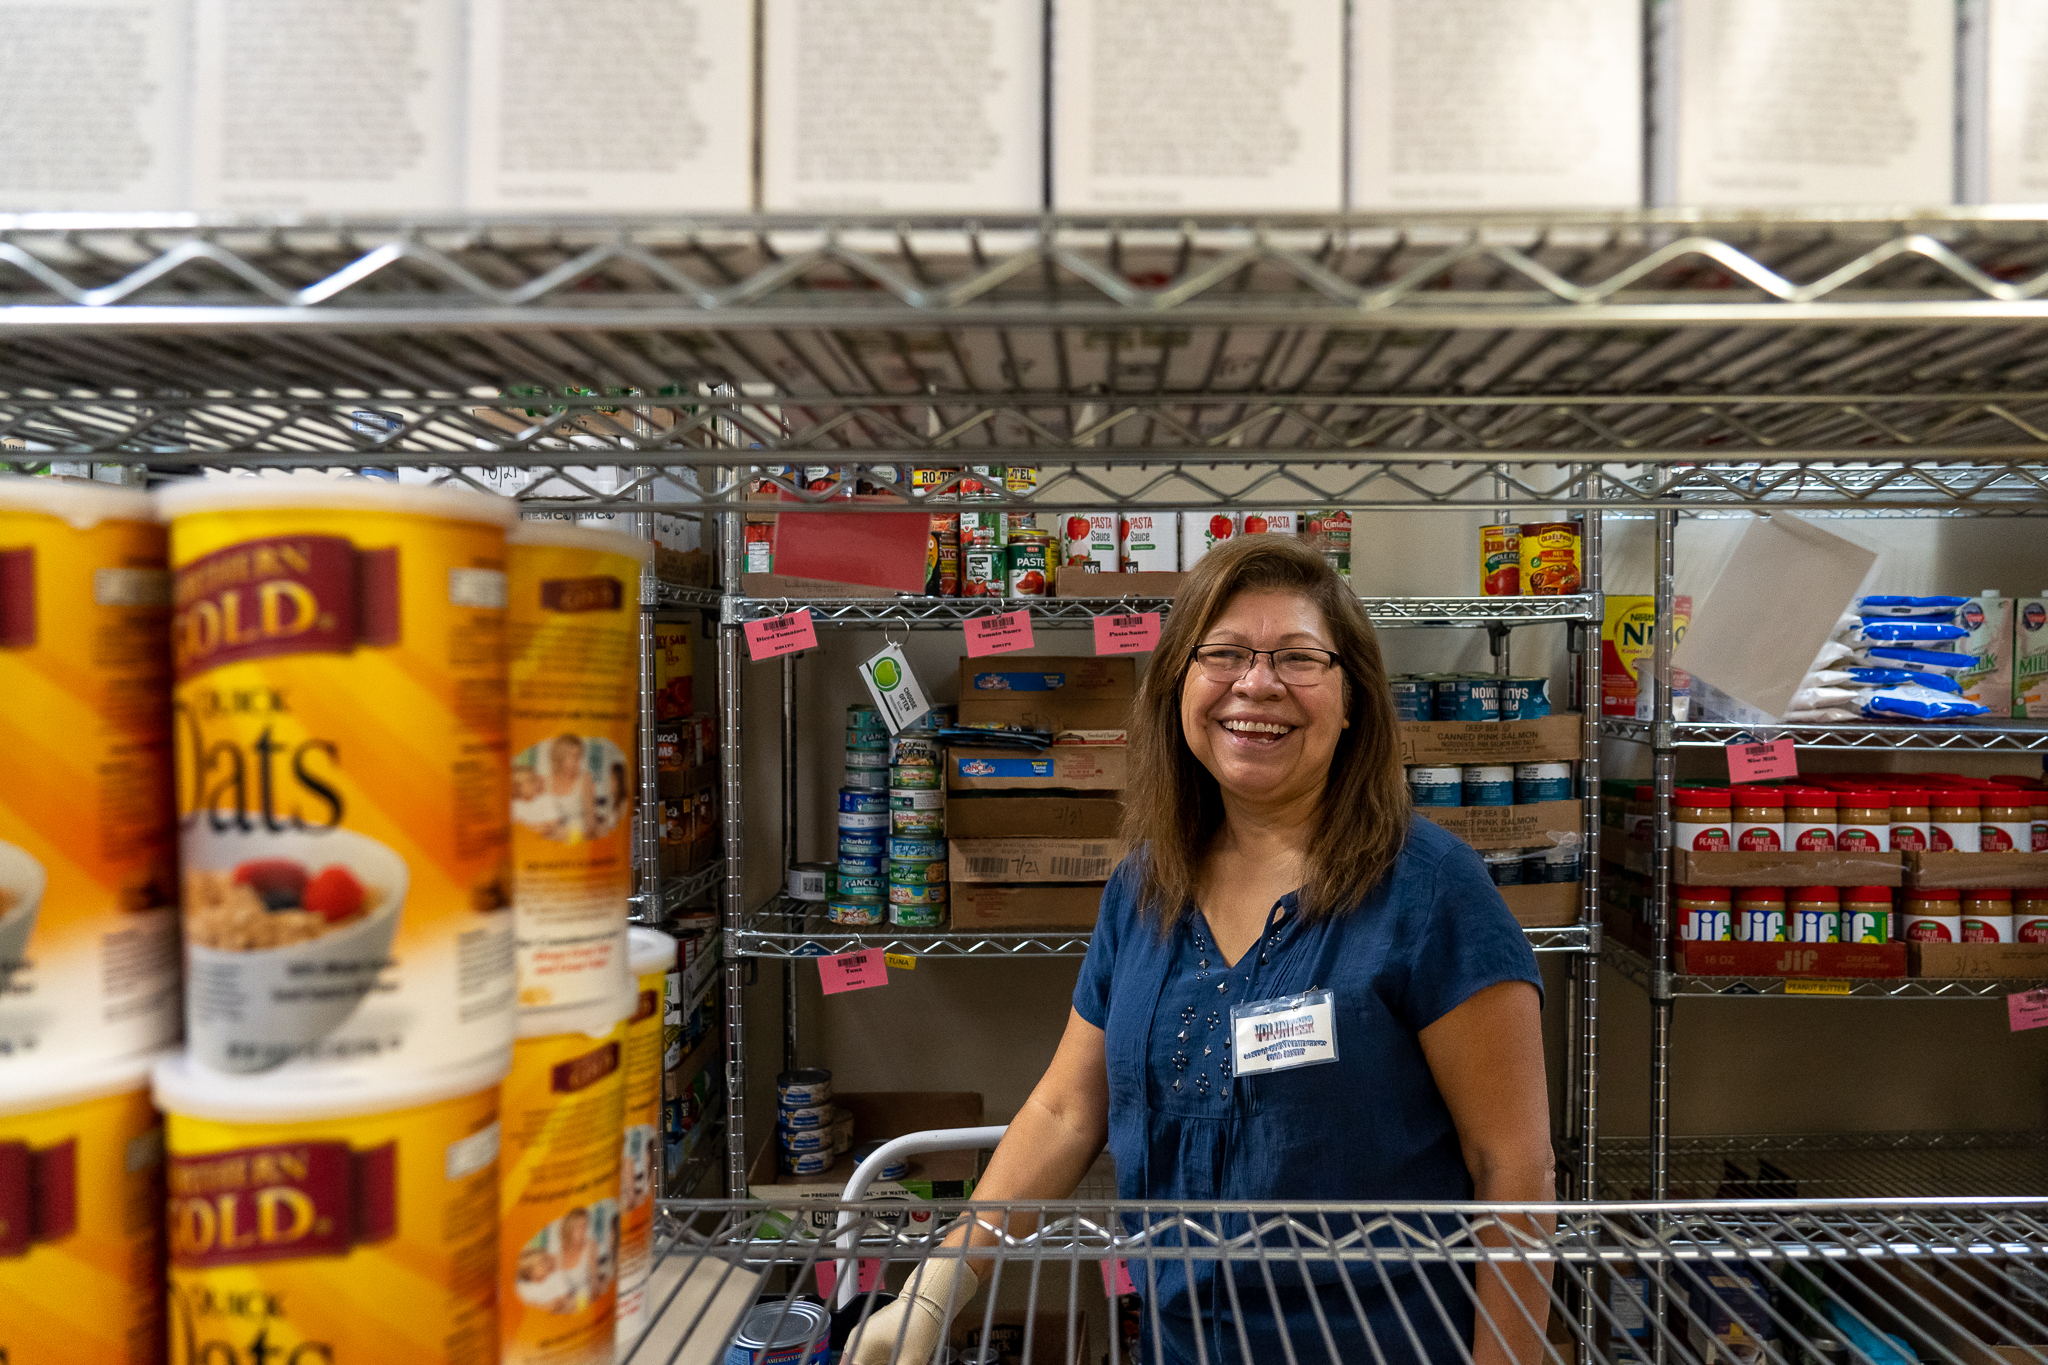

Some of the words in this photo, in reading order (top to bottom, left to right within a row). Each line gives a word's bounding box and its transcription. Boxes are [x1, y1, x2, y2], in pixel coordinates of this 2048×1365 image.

[1090, 516, 1112, 530] PASTA
[1129, 516, 1153, 530] PASTA
[1268, 515, 1290, 529] PASTA
[1090, 530, 1111, 542] Sauce
[1130, 530, 1150, 542] Sauce
[1484, 540, 1504, 554] RED
[1506, 537, 1520, 551] G
[1016, 558, 1045, 568] PASTE
[1630, 613, 1655, 622] Nestl
[756, 634, 775, 642] Diced
[776, 628, 807, 638] Tomatoes
[977, 631, 1002, 639] Tomato
[903, 686, 918, 710] CHOOSE
[1471, 687, 1499, 699] LMON
[1501, 687, 1529, 700] SALM
[898, 692, 911, 712] OFTEN
[1501, 699, 1520, 710] PIN
[1465, 724, 1483, 732] DEEP
[1484, 724, 1499, 732] SEA
[657, 732, 678, 742] uce's
[1437, 733, 1476, 741] CANNED
[1477, 732, 1499, 741] PINK
[1501, 731, 1538, 740] SALMON
[659, 746, 673, 757] MS
[963, 764, 995, 773] ANCLA
[1465, 809, 1482, 817] DEEP
[1436, 819, 1475, 827] CANNED
[1476, 818, 1498, 826] PINK
[1501, 816, 1538, 826] SALMON
[1698, 837, 1725, 846] PEANUT
[1743, 837, 1771, 846] PEANUT
[1802, 838, 1829, 846] PEANUT
[1840, 838, 1868, 847] PEANUT
[842, 858, 866, 866] StarKist
[1011, 854, 1040, 876] 7/21
[850, 879, 880, 887] ANCLA
[890, 889, 910, 898] NCLA
[1680, 912, 1730, 942] Jif
[1734, 912, 1784, 942] Jif
[1786, 912, 1838, 943] Jif
[1841, 912, 1876, 943] if
[888, 956, 909, 966] TUNA
[1704, 954, 1716, 964] 16
[1718, 954, 1735, 964] OZ
[1776, 950, 1818, 972] Jif
[1787, 982, 1817, 992] PEANUT
[1818, 982, 1848, 992] BUTTER
[1254, 1014, 1315, 1042] VOLUNTEER
[766, 1354, 794, 1364] AMERICA'S
